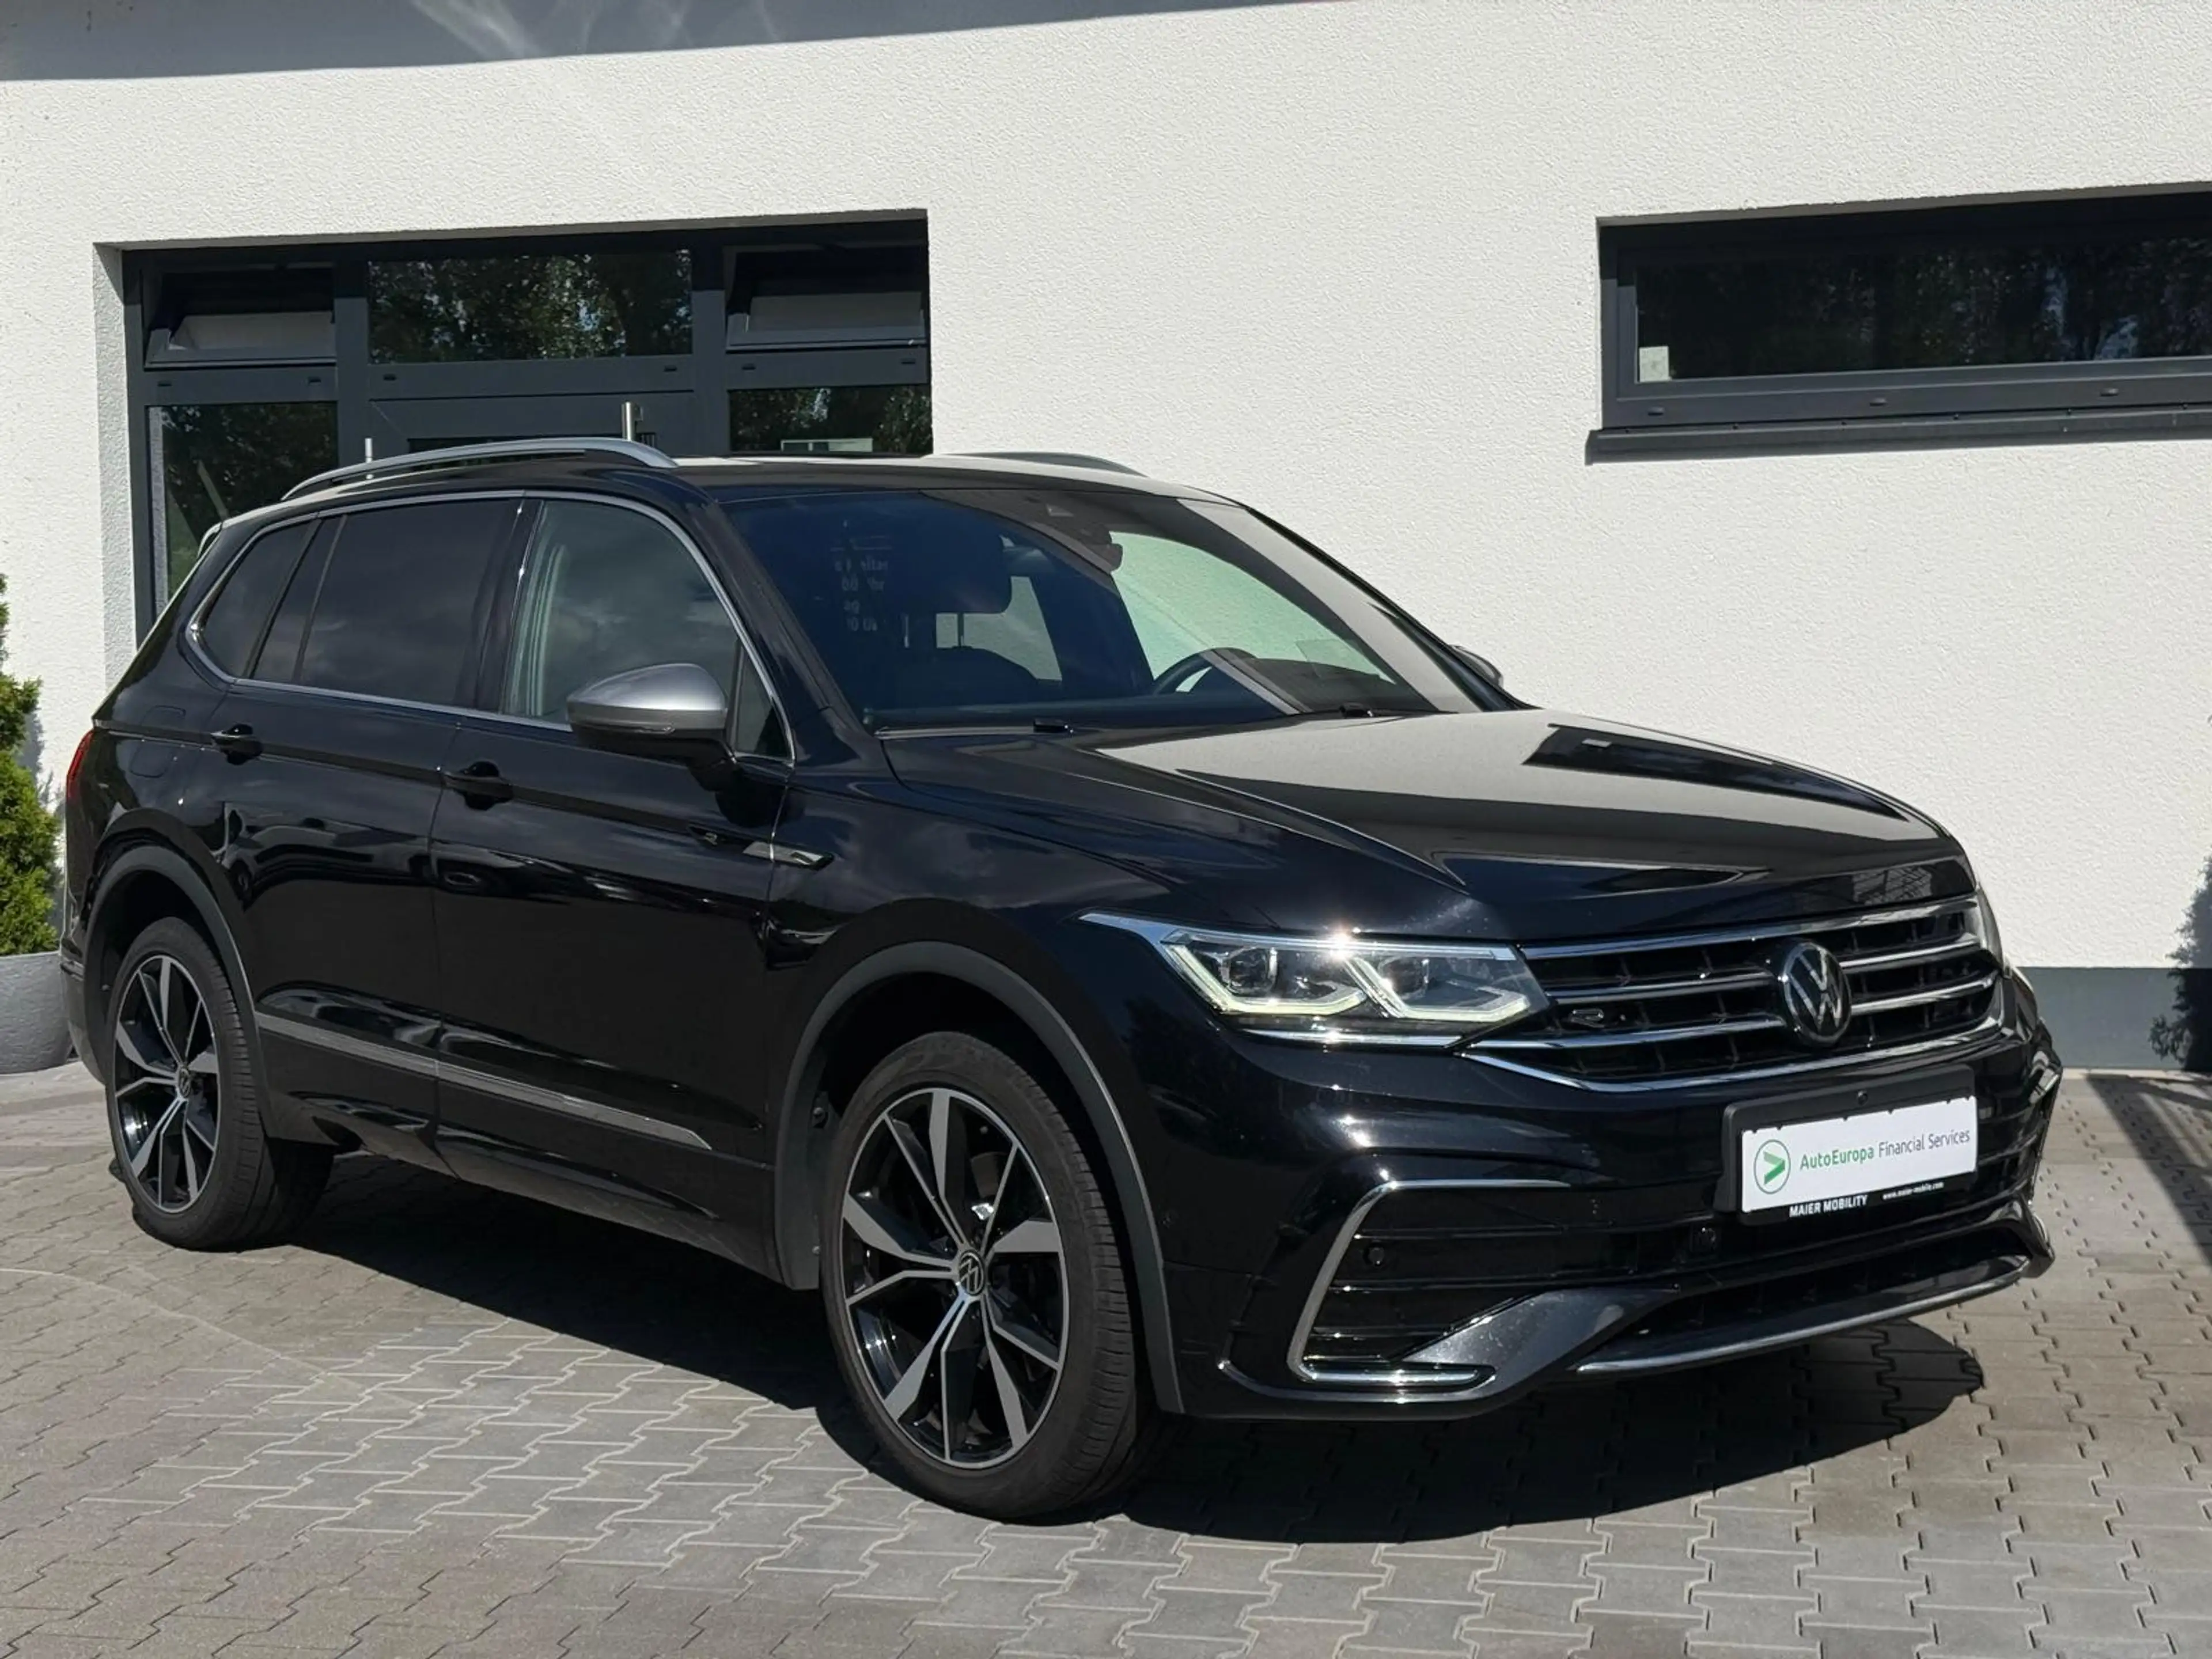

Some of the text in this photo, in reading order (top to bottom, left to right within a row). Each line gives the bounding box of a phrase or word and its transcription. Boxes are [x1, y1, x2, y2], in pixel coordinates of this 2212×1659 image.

[1800, 1130, 1970, 1171] AutoEuropa Financial Services
[1789, 1194, 1868, 1217] MAIER MOBILITY
